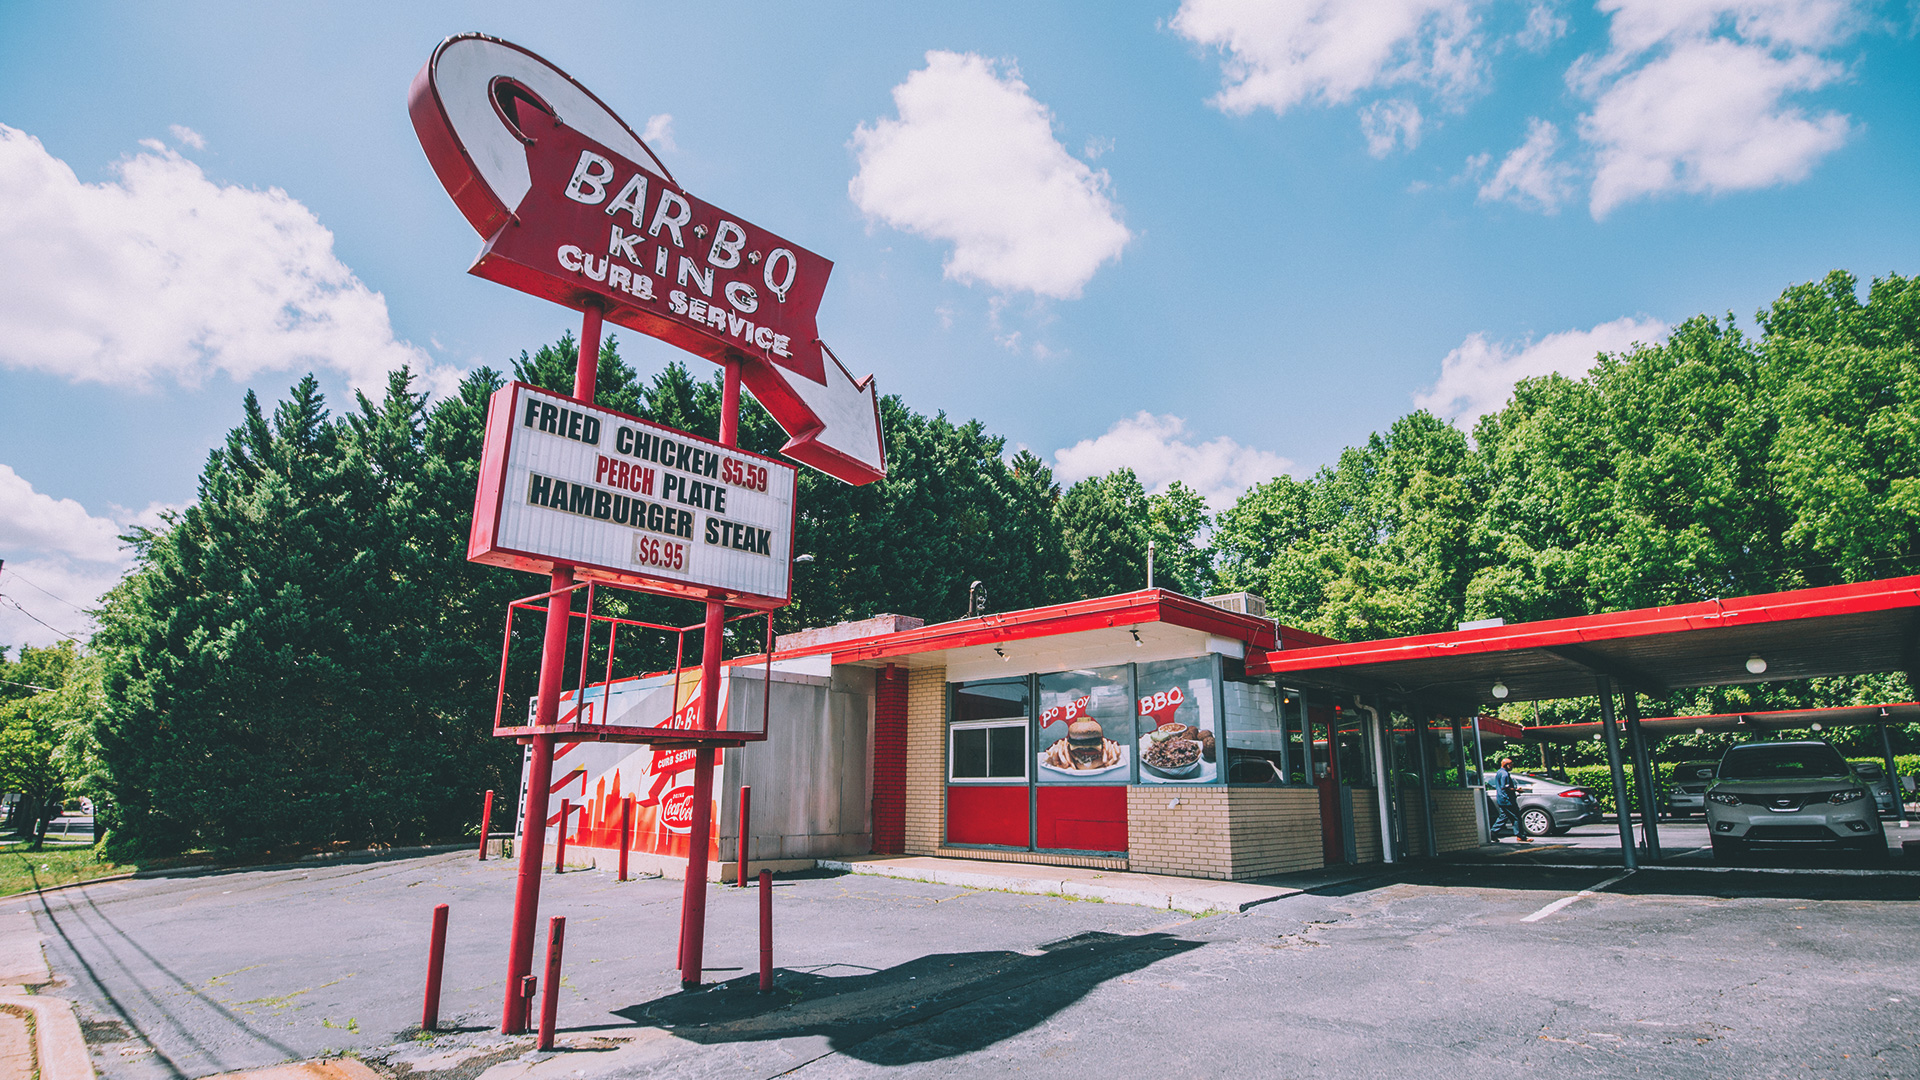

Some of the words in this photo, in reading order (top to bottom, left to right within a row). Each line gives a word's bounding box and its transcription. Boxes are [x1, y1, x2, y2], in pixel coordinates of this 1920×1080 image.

[557, 244, 656, 301] CURB
[668, 290, 793, 359] SERVICE
[608, 223, 759, 314] KING
[524, 397, 600, 446] FRIED
[616, 425, 719, 480] CHICKEN
[721, 455, 768, 492] $5.59
[530, 473, 694, 539] HAMBURGER
[704, 516, 772, 556] STEAK
[595, 454, 655, 496] PERCH
[662, 472, 726, 514] PLATE
[639, 535, 684, 571] $6.95
[1140, 686, 1185, 715] BBQ
[657, 755, 674, 769] CURB
